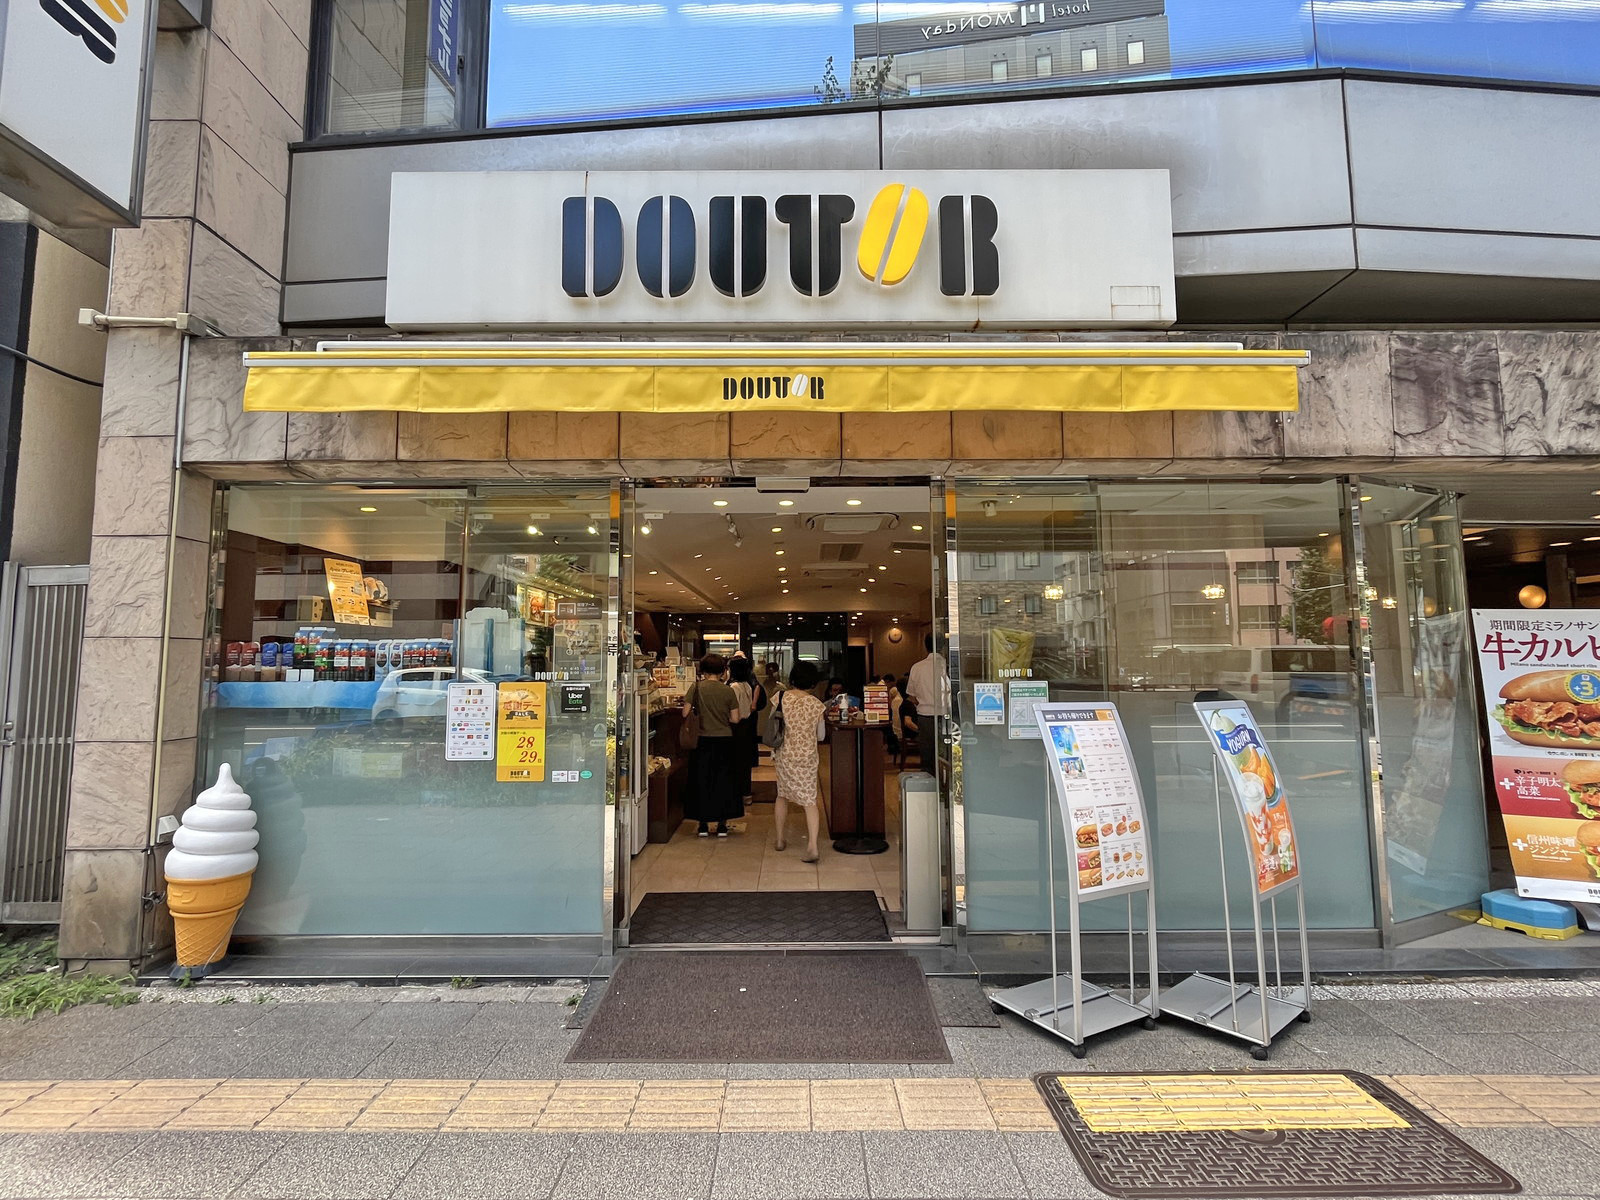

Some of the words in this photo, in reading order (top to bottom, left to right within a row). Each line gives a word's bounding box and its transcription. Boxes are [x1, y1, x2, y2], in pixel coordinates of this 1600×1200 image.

[561, 183, 1000, 298] DOUTOR
[723, 373, 825, 400] DOUTOR
[535, 671, 569, 681] DOUTOR
[998, 668, 1033, 678] DOUTOR
[516, 736, 535, 748] 28
[518, 751, 538, 763] 29
